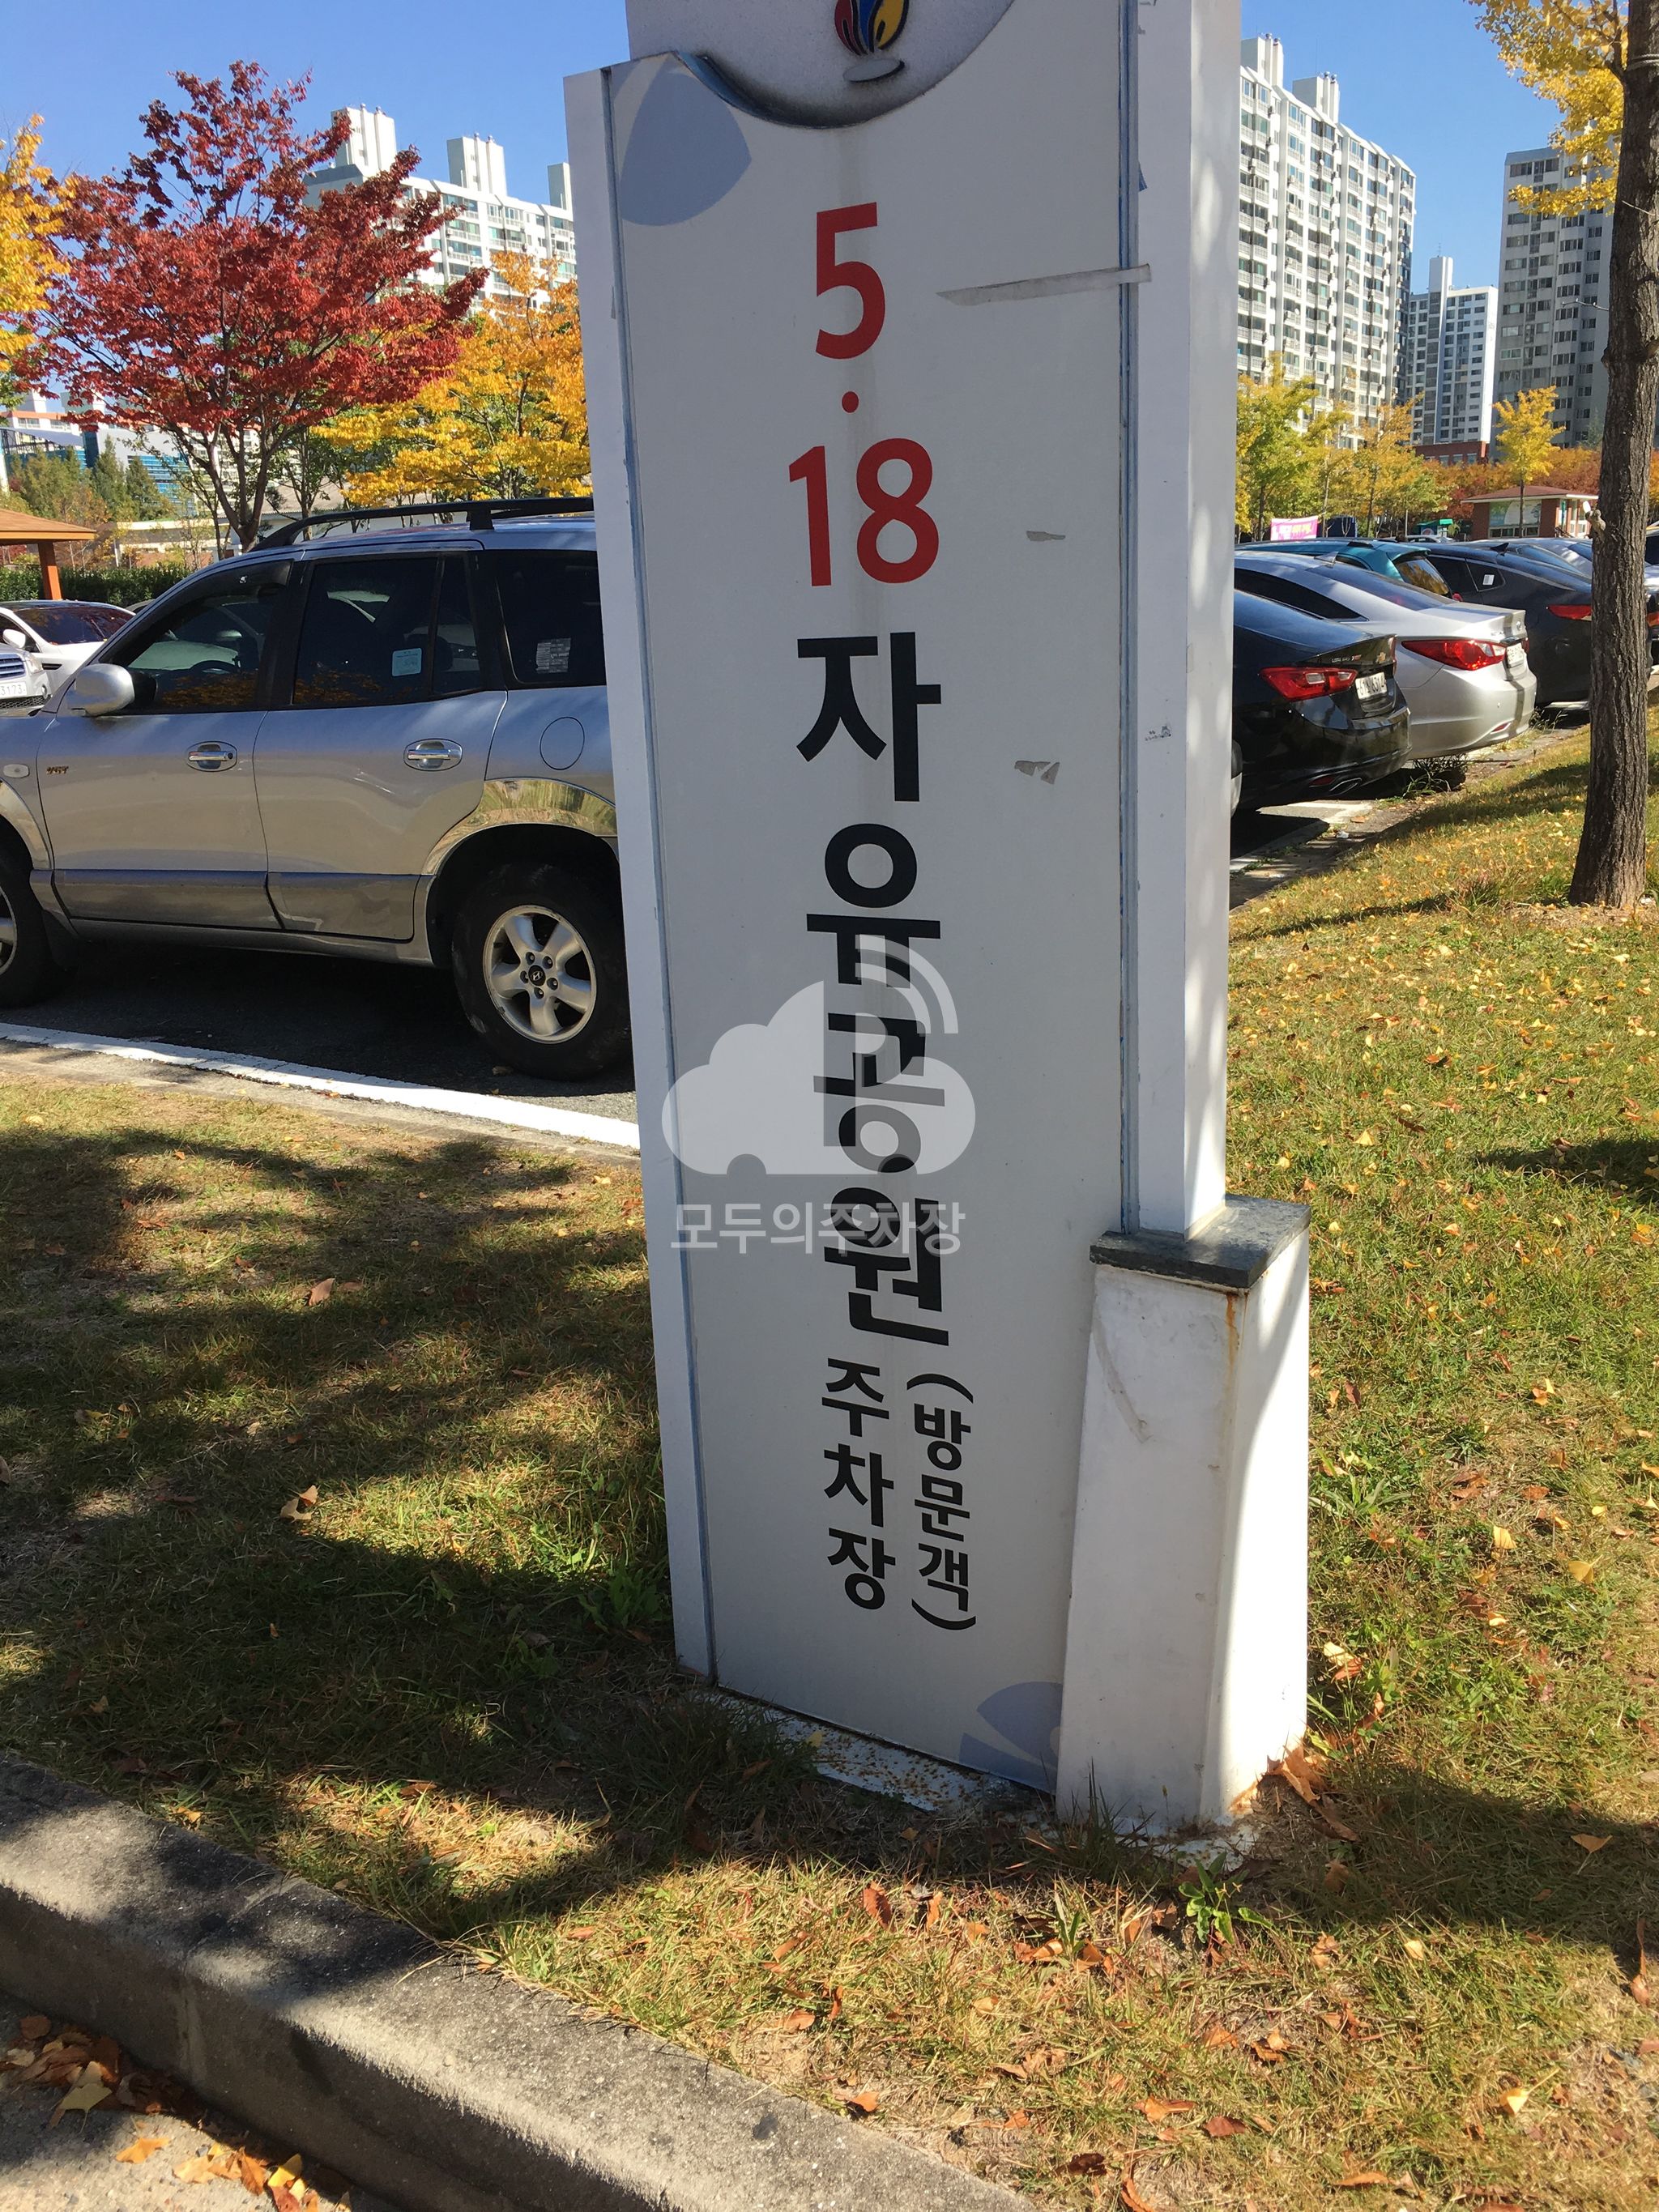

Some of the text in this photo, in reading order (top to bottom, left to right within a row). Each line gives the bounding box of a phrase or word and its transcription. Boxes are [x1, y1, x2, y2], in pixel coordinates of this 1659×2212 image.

[795, 631, 949, 1346] 자유공원
[821, 1357, 896, 1610] 주차장
[906, 1373, 976, 1631] (방문객)
